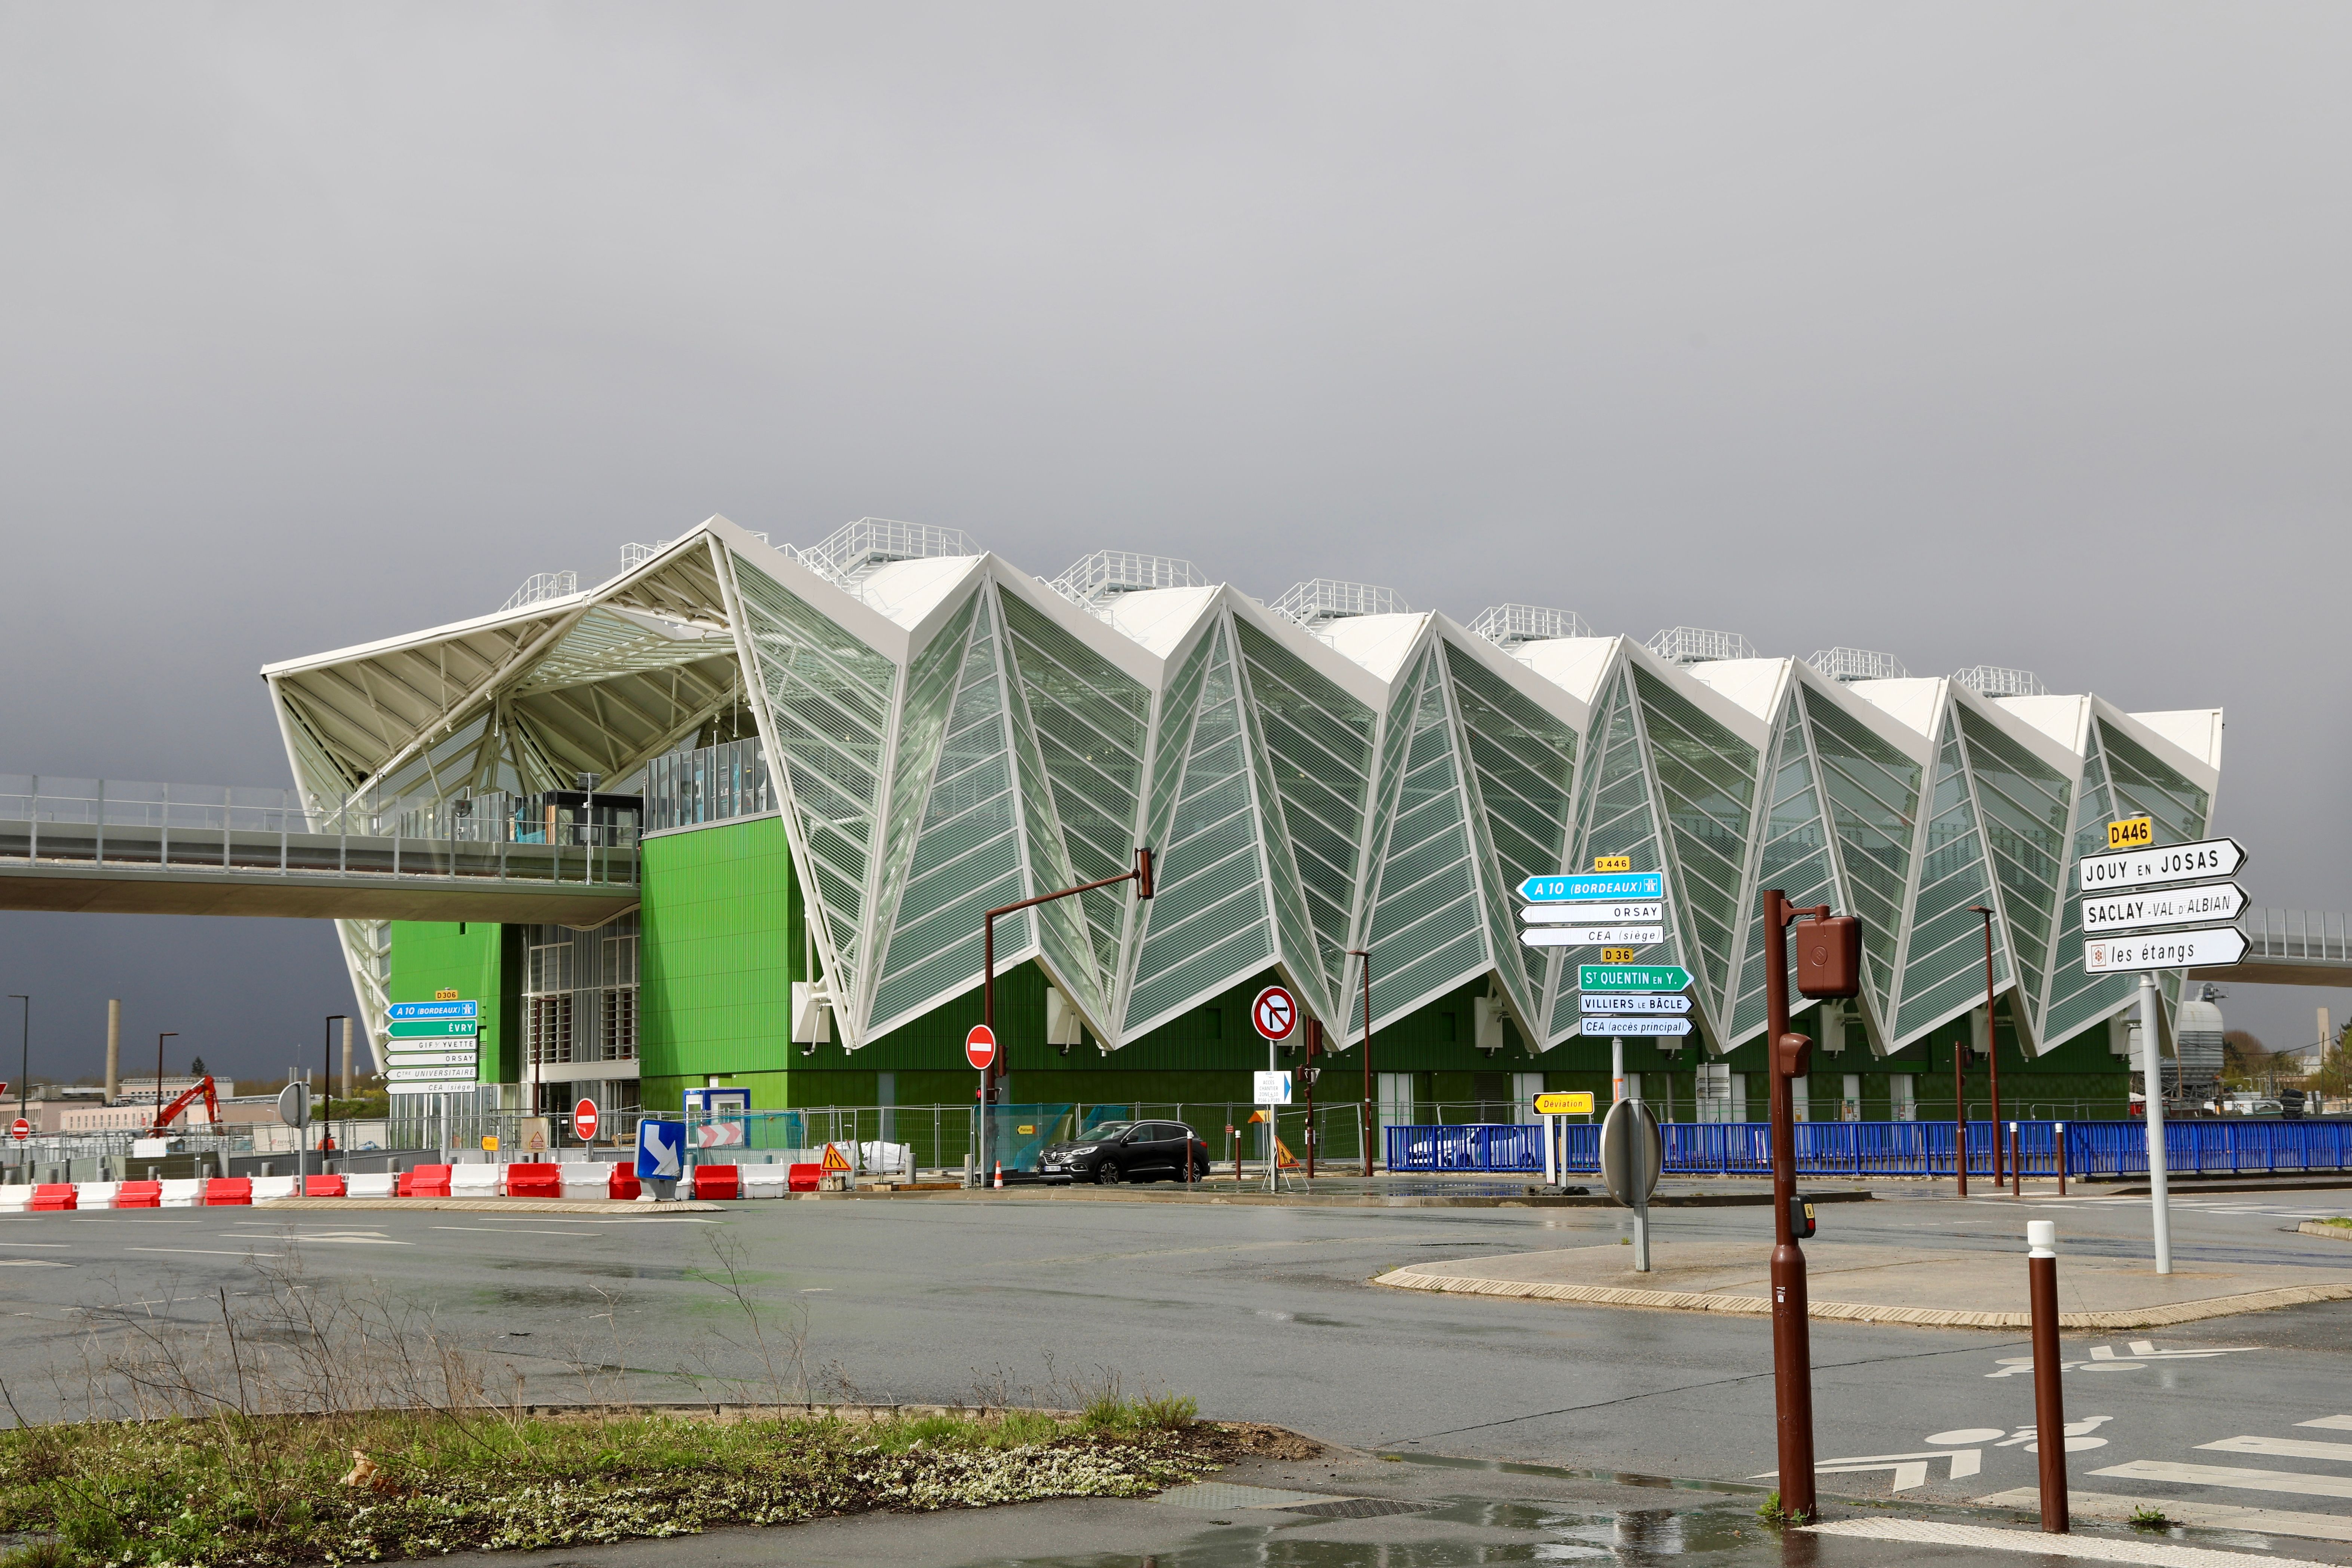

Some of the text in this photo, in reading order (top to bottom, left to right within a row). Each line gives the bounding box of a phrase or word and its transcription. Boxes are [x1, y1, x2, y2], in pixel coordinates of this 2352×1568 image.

[2086, 850, 2218, 882] JOUY EN JOSAS
[1534, 881, 1642, 895] A 10 (BORDEAUX)
[1614, 907, 1657, 917] ORSAY
[2089, 901, 2143, 923] SACLAY
[1589, 930, 1660, 942] CEA (siège)
[2111, 943, 2194, 963] les étangs
[1601, 972, 1649, 984] QUENTIN
[1666, 973, 1677, 984] Y.
[1585, 999, 1633, 1008] VILLIERS
[1650, 998, 1682, 1009] BÂCLE
[417, 1007, 460, 1015] (BORDEAUX)
[449, 1023, 473, 1032] ÉVRY
[1586, 1021, 1684, 1033] CEA (accès principal)
